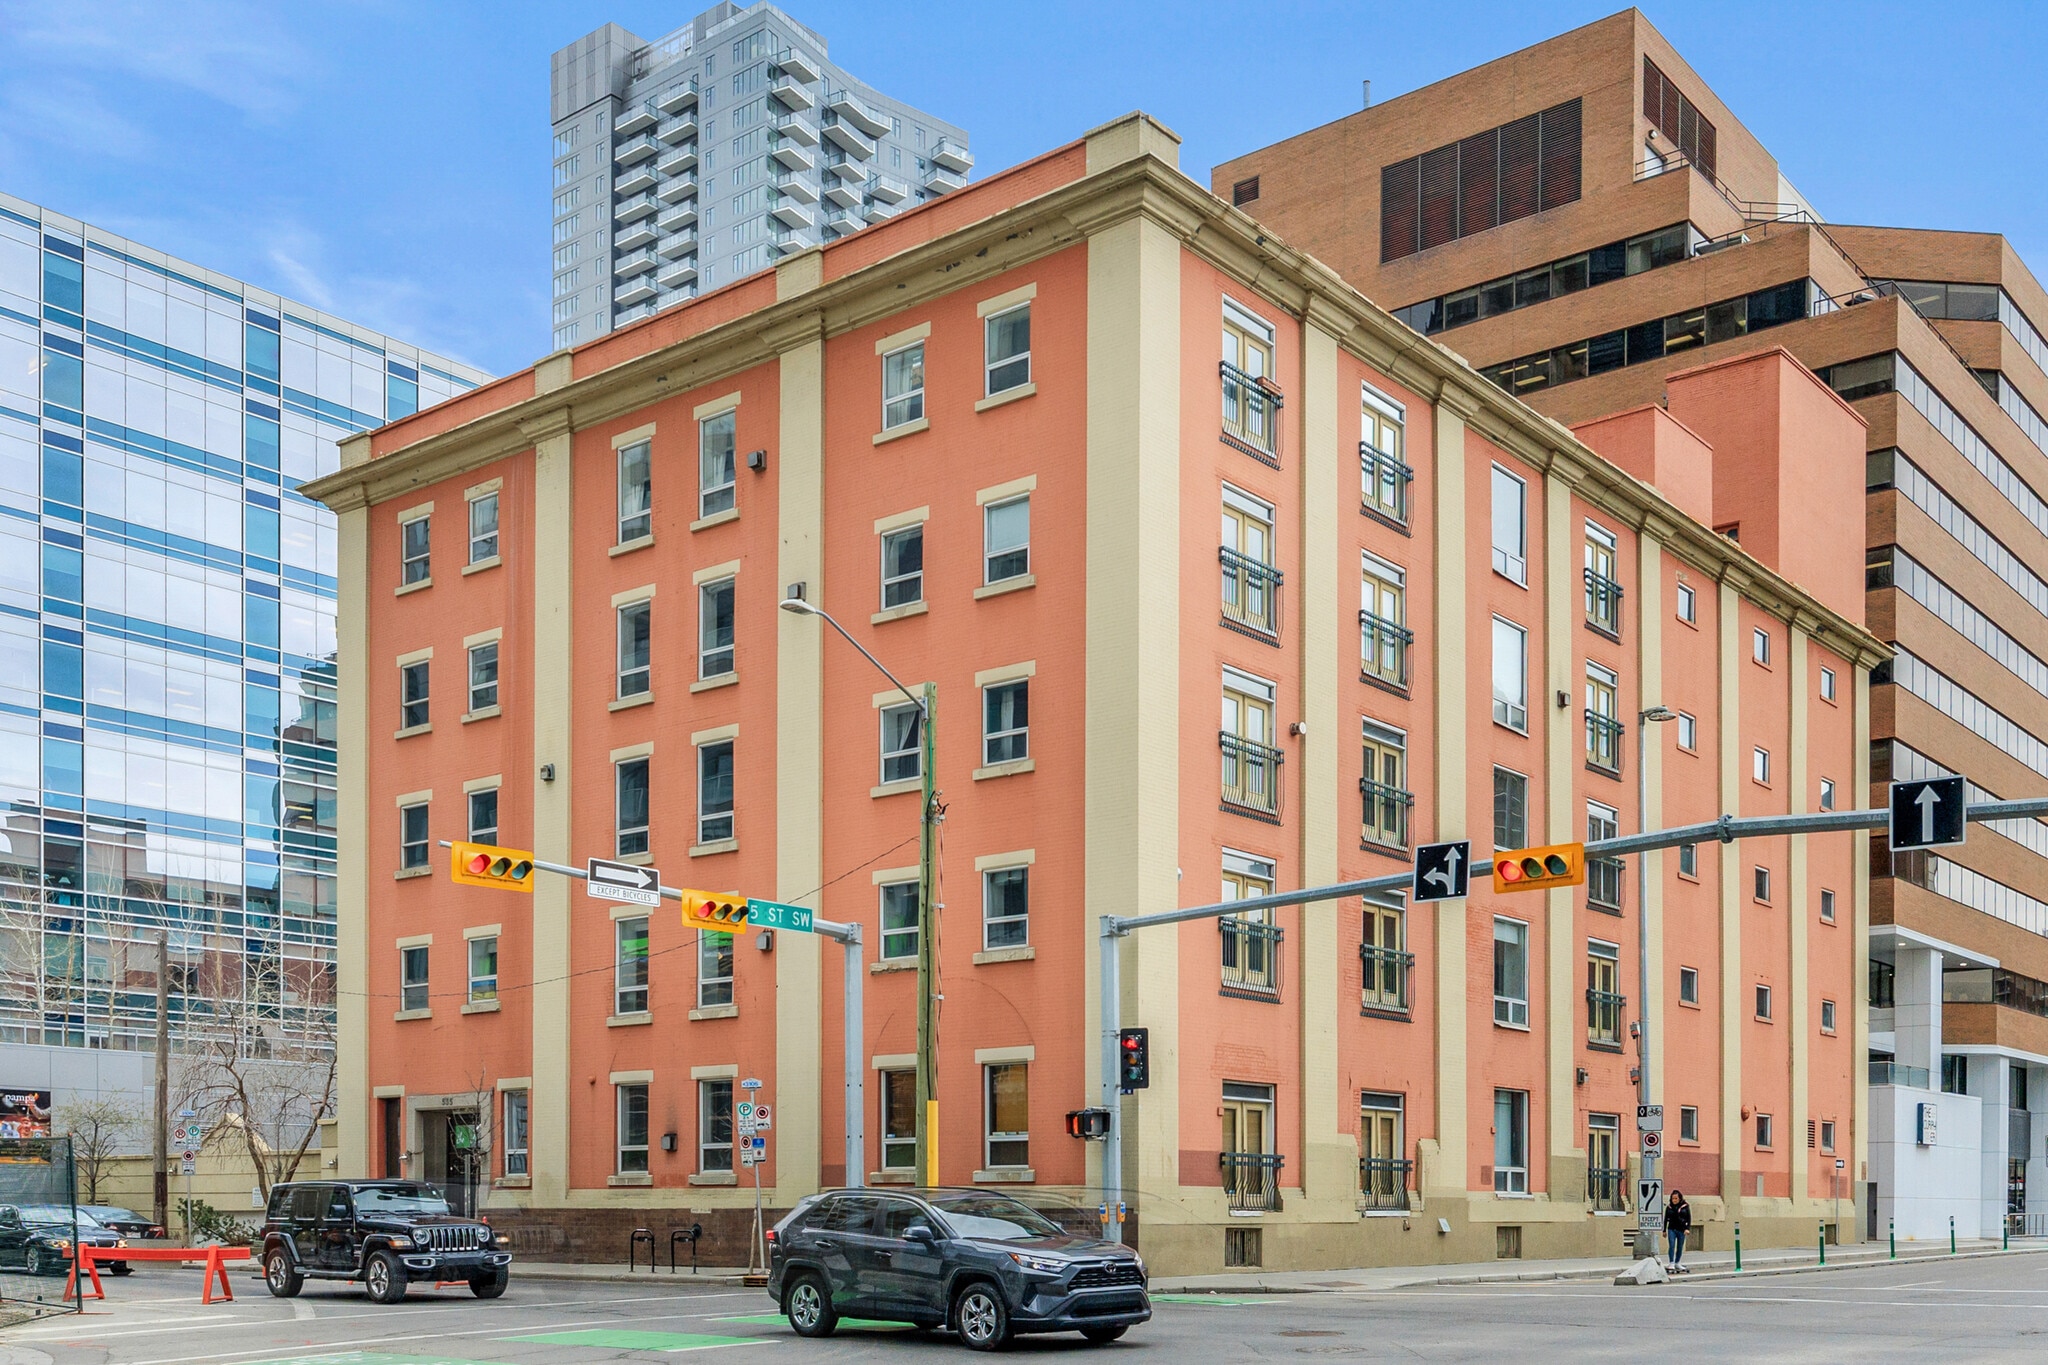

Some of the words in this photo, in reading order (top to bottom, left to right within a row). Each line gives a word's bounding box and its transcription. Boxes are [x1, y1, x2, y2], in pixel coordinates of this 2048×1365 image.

[597, 886, 620, 896] EXCEPT
[622, 889, 651, 902] BICYCLES
[750, 904, 759, 920] 5
[768, 907, 784, 923] ST
[792, 911, 810, 928] SW
[5, 1094, 36, 1104] pampa
